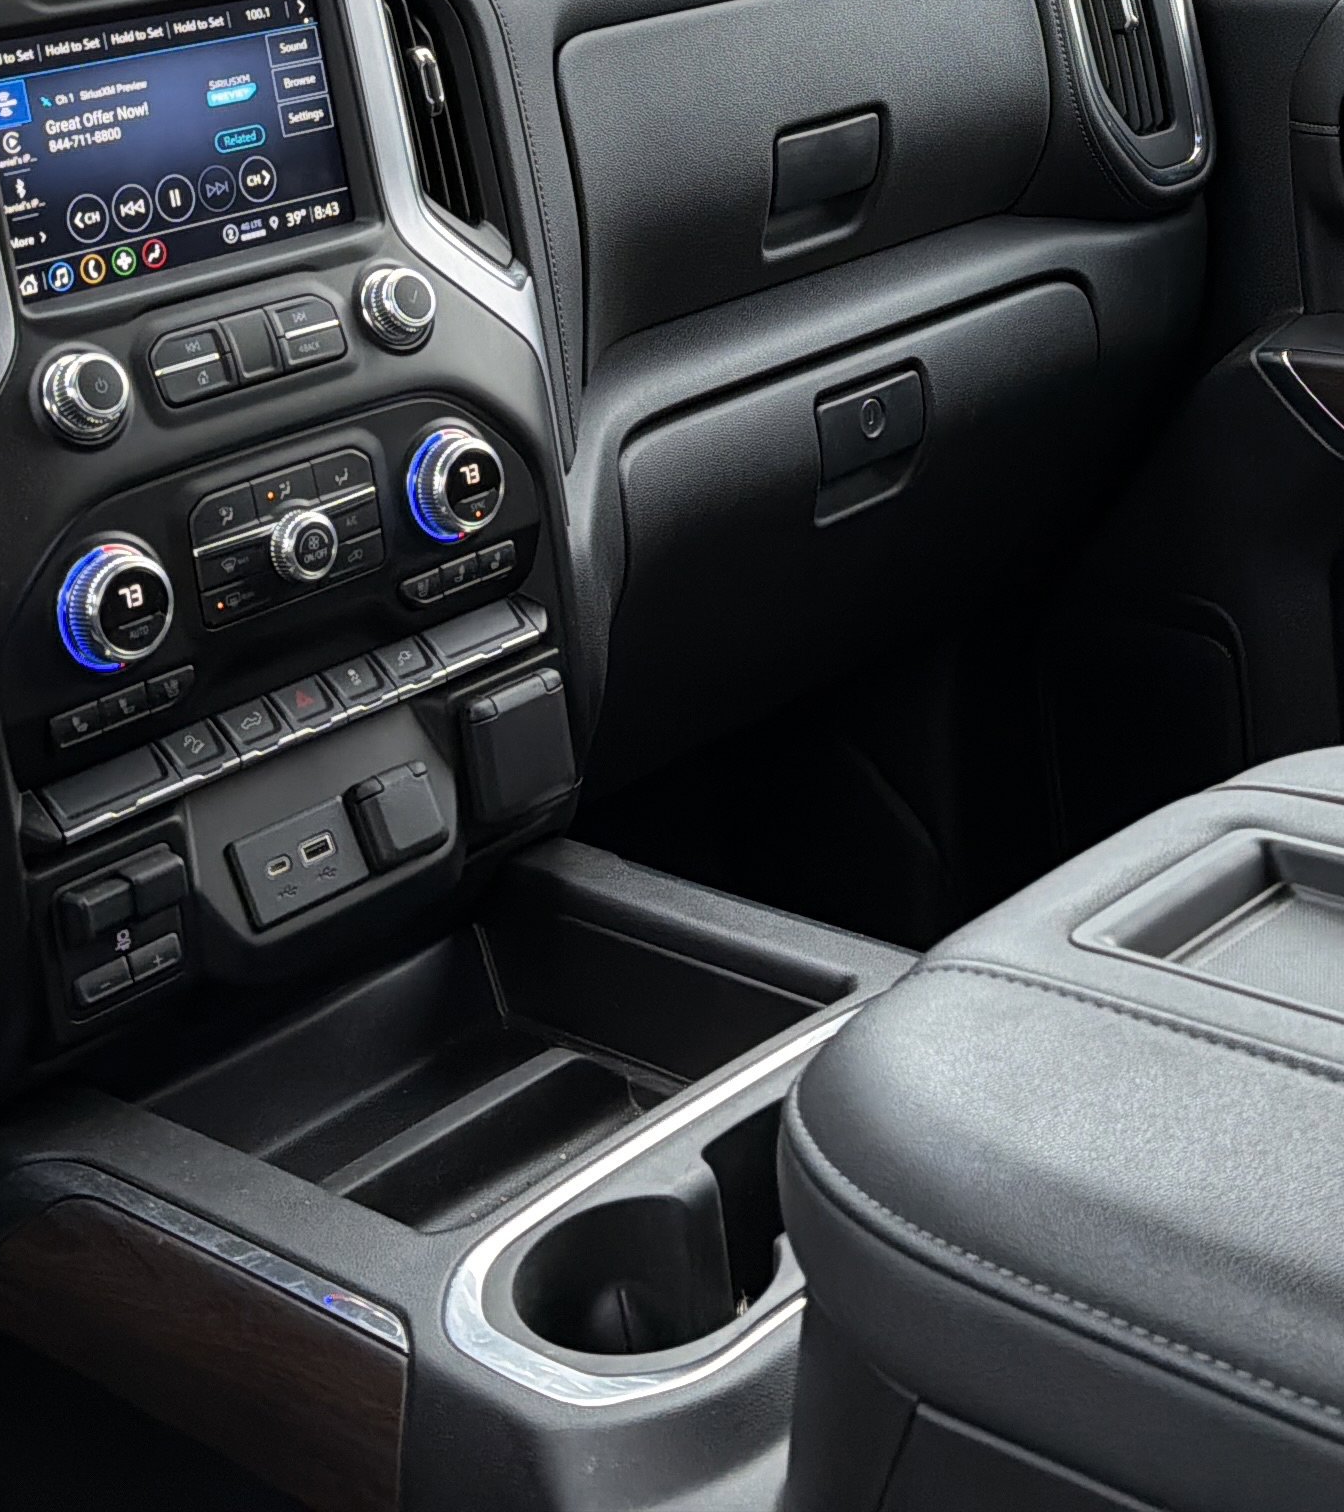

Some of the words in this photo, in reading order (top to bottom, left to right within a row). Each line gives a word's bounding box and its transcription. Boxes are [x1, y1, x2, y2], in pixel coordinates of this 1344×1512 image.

[245, 6, 271, 21] 100.1
[173, 21, 196, 34] Hold
[197, 20, 208, 30] to
[208, 16, 225, 29] Set
[110, 32, 135, 45] Hold
[135, 31, 146, 40] to
[147, 26, 164, 38] Set
[45, 42, 70, 57] Hold
[71, 43, 82, 52] to
[83, 38, 101, 51] Set
[279, 38, 308, 54] Sound
[4, 55, 15, 64] to
[16, 49, 35, 63] Set
[414, 65, 437, 75] PASS
[435, 68, 451, 76] AIR
[283, 74, 317, 89] Browse
[55, 94, 68, 106] Ch
[116, 80, 147, 94] Preview
[45, 116, 82, 135] Great
[82, 109, 114, 127] Offer
[116, 101, 149, 121] Now!
[288, 108, 324, 125] Settings
[48, 127, 122, 153] 844-711-8800
[223, 131, 257, 146] Related
[246, 174, 261, 187] CH
[84, 211, 101, 225] CH
[313, 201, 340, 220] 8:43
[459, 463, 481, 485] 73
[304, 547, 328, 564] ON/OFF
[118, 583, 144, 609] 73
[130, 625, 150, 640] AUTO
